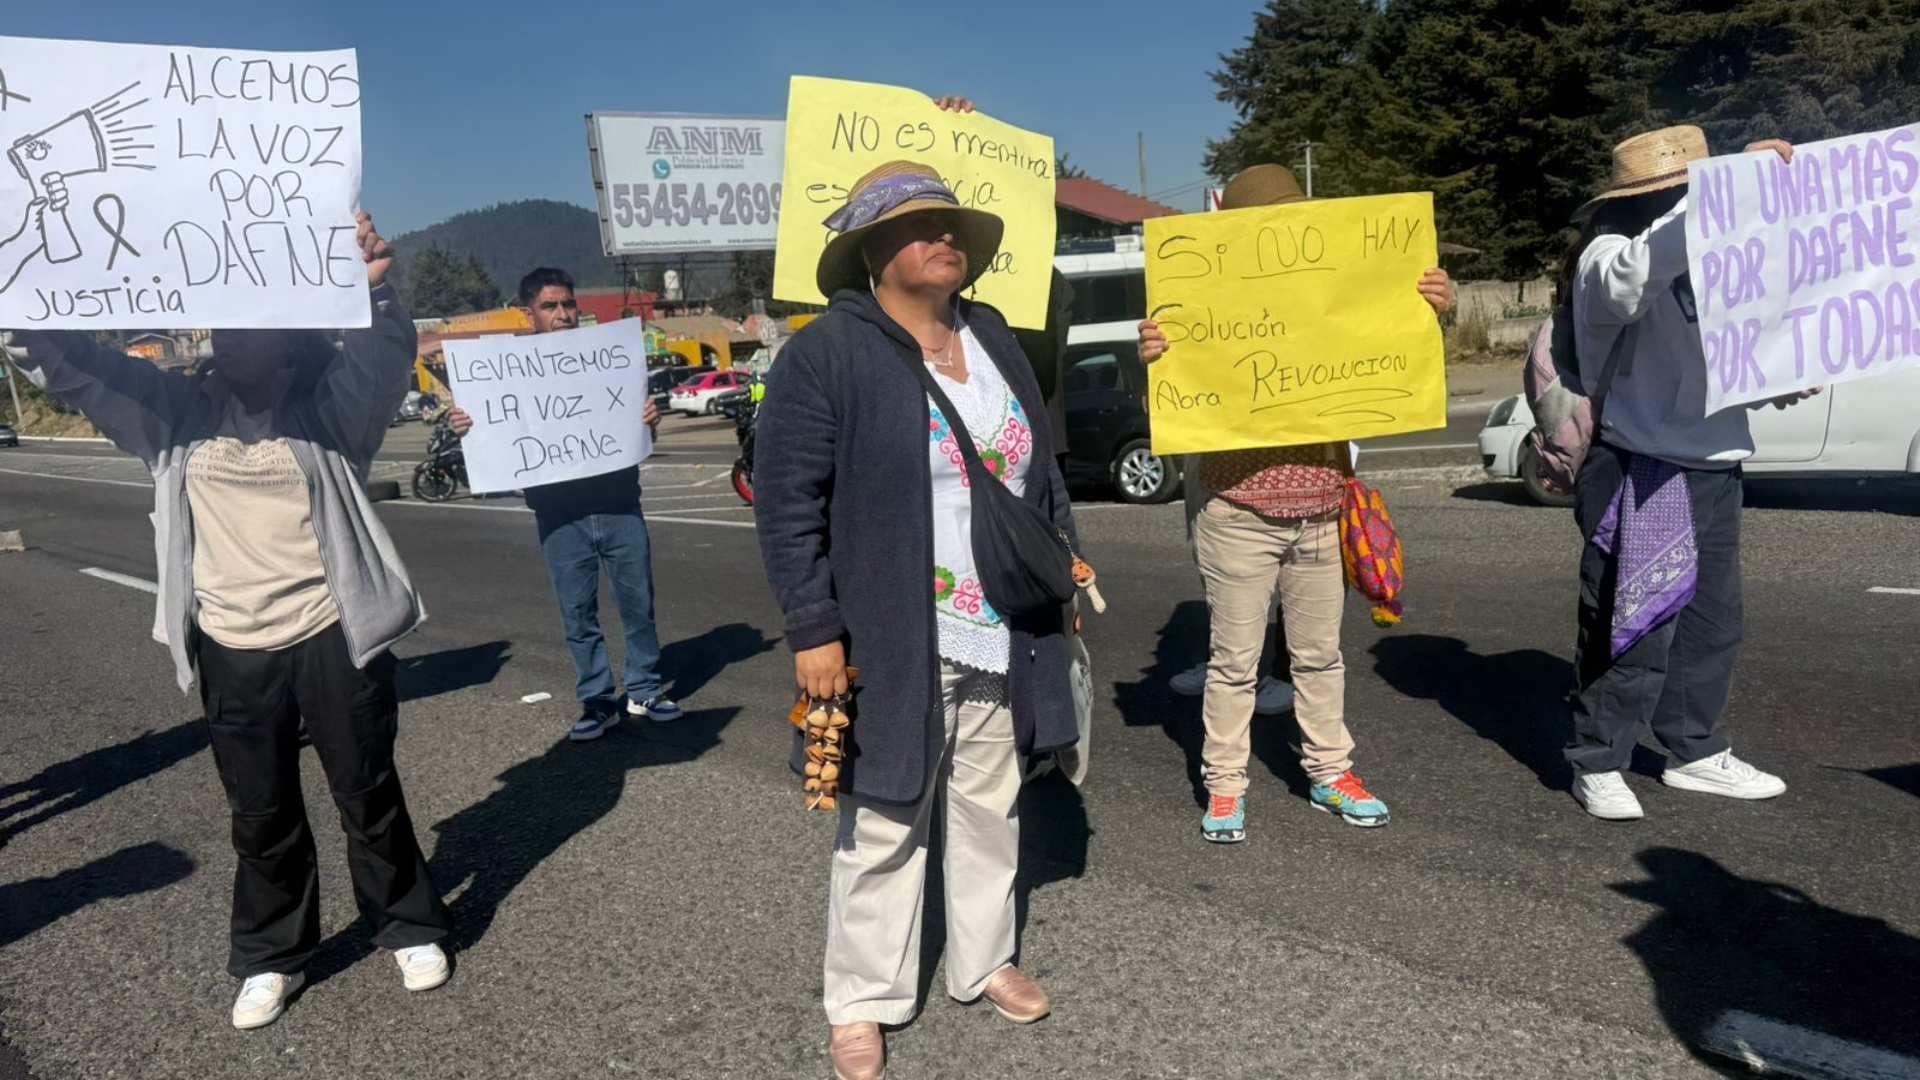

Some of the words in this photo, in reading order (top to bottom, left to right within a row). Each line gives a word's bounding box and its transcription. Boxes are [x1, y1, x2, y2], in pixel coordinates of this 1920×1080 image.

[164, 52, 361, 108] ALCEMOS
[178, 117, 235, 160] LA
[250, 123, 345, 167] VOZ
[646, 126, 764, 156] ANM
[832, 111, 879, 152] NO
[896, 122, 935, 152] es
[952, 130, 1051, 179] mentira
[209, 168, 312, 221] POR
[1700, 164, 1736, 239] NI
[164, 220, 357, 288] DAFNE
[1256, 225, 1325, 272] NO
[1363, 216, 1420, 259] HAY
[1701, 236, 1766, 318] POR
[1788, 196, 1915, 295] DAFNE
[1233, 350, 1408, 402] REVOLUCION
[1705, 317, 1766, 394] POR
[486, 394, 521, 424] LA
[534, 394, 592, 421] VOZ
